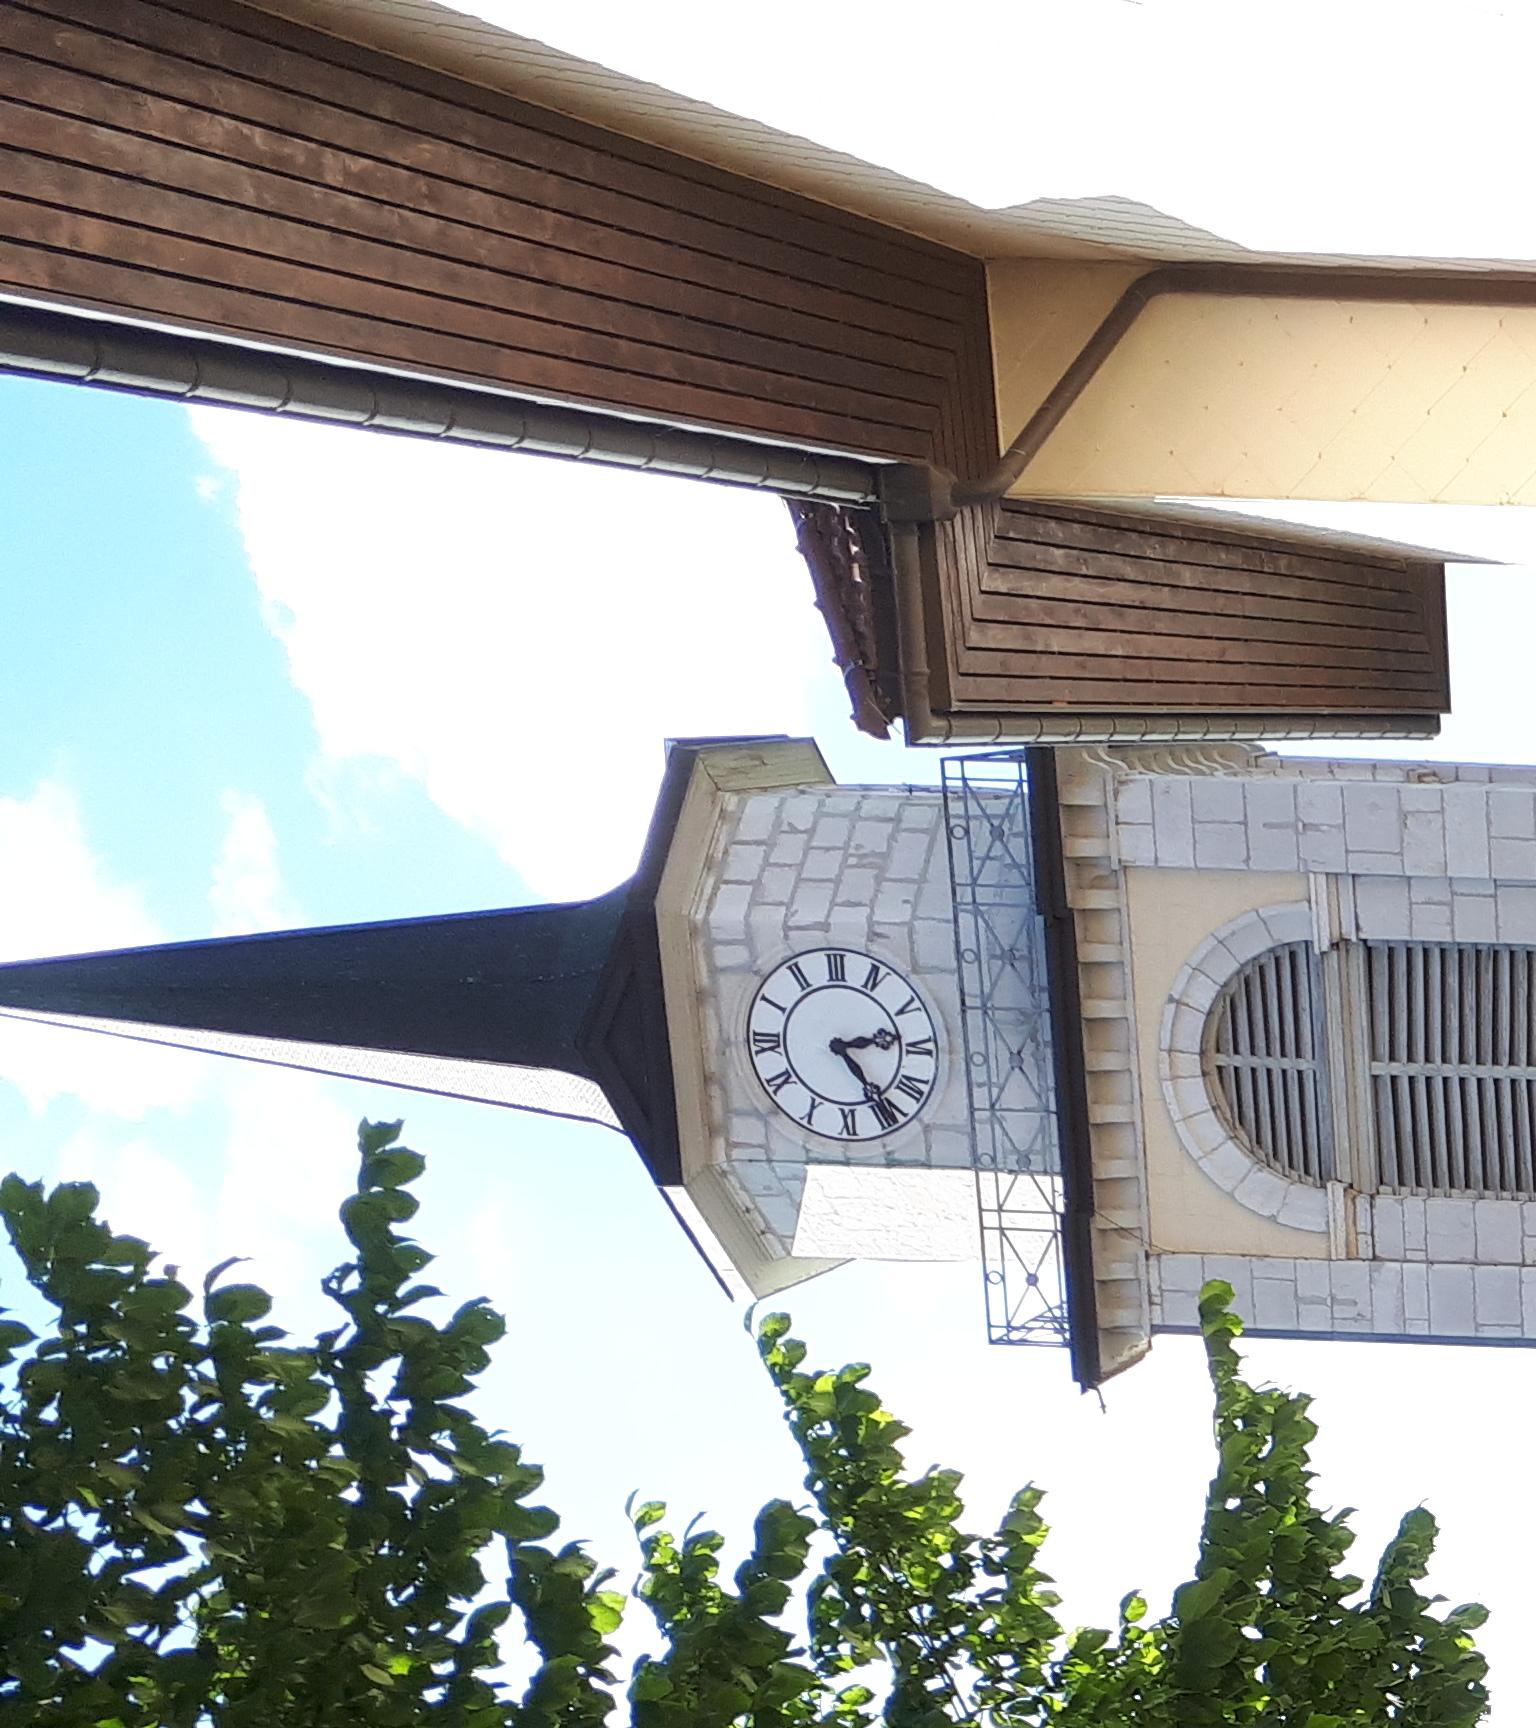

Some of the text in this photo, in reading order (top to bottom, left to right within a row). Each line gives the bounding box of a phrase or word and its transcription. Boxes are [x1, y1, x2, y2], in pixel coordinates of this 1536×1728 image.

[785, 961, 812, 992] II
[824, 953, 847, 982] III
[861, 962, 892, 992] IV
[760, 993, 787, 1014] I
[894, 995, 922, 1017] V
[753, 1029, 782, 1057] XII
[905, 1035, 933, 1058] VI
[765, 1067, 798, 1096] XI
[894, 1074, 930, 1104] VII
[799, 1096, 824, 1126] X
[837, 1107, 859, 1137] IX
